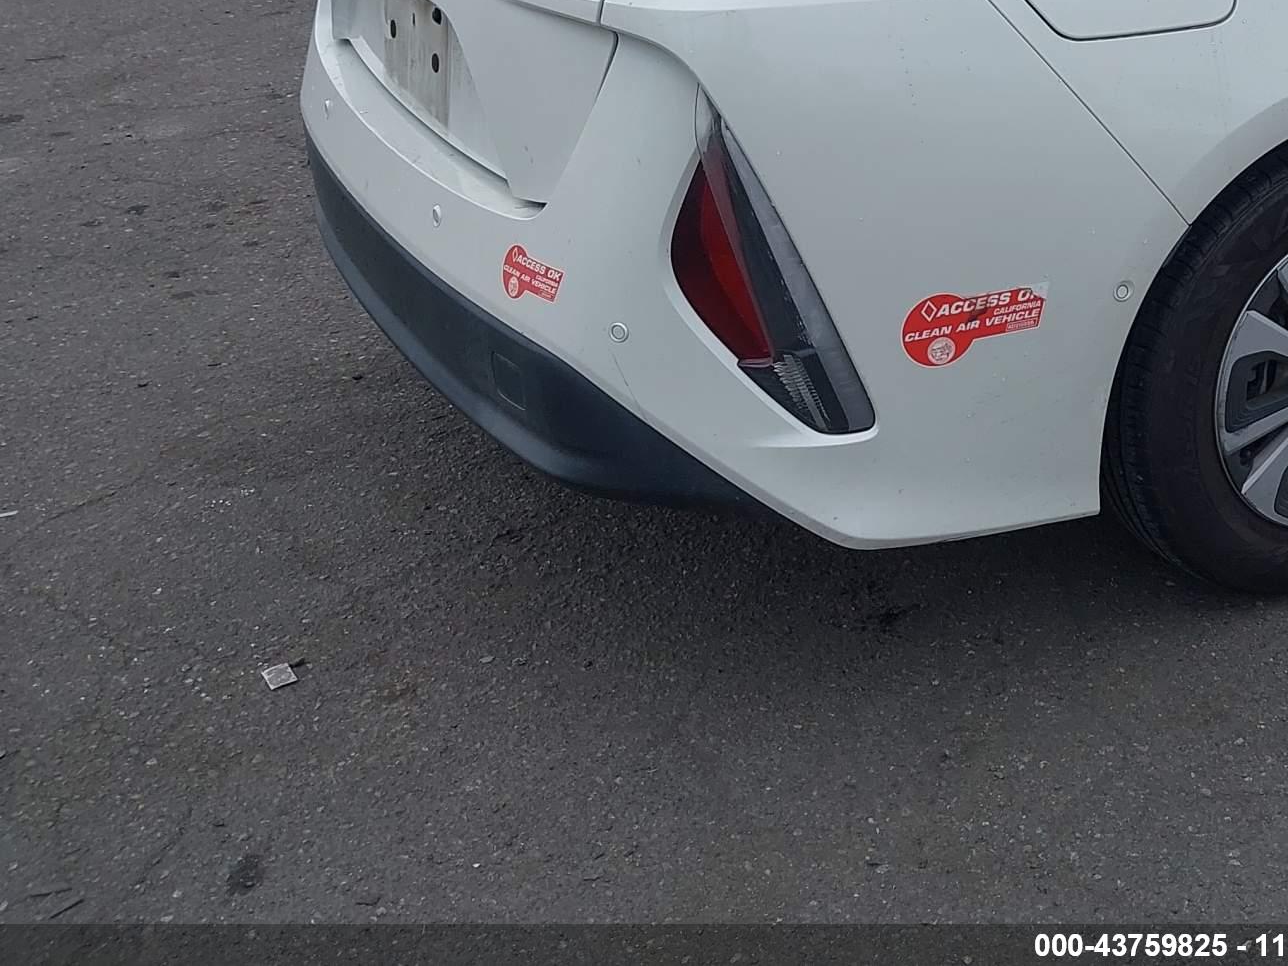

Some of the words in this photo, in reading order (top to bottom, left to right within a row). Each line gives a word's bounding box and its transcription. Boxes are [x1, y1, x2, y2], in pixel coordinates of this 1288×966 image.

[503, 264, 521, 278] CLEAN
[520, 274, 531, 283] AIR
[531, 279, 557, 294] VEHICLE
[516, 254, 546, 275] ACCESS
[547, 268, 562, 282] OK
[935, 292, 1012, 318] ACCESS
[993, 300, 1042, 316] CALIFORNIA
[904, 325, 952, 343] CLEAN
[956, 320, 980, 333] AIR
[985, 308, 1041, 327] VEHICLE
